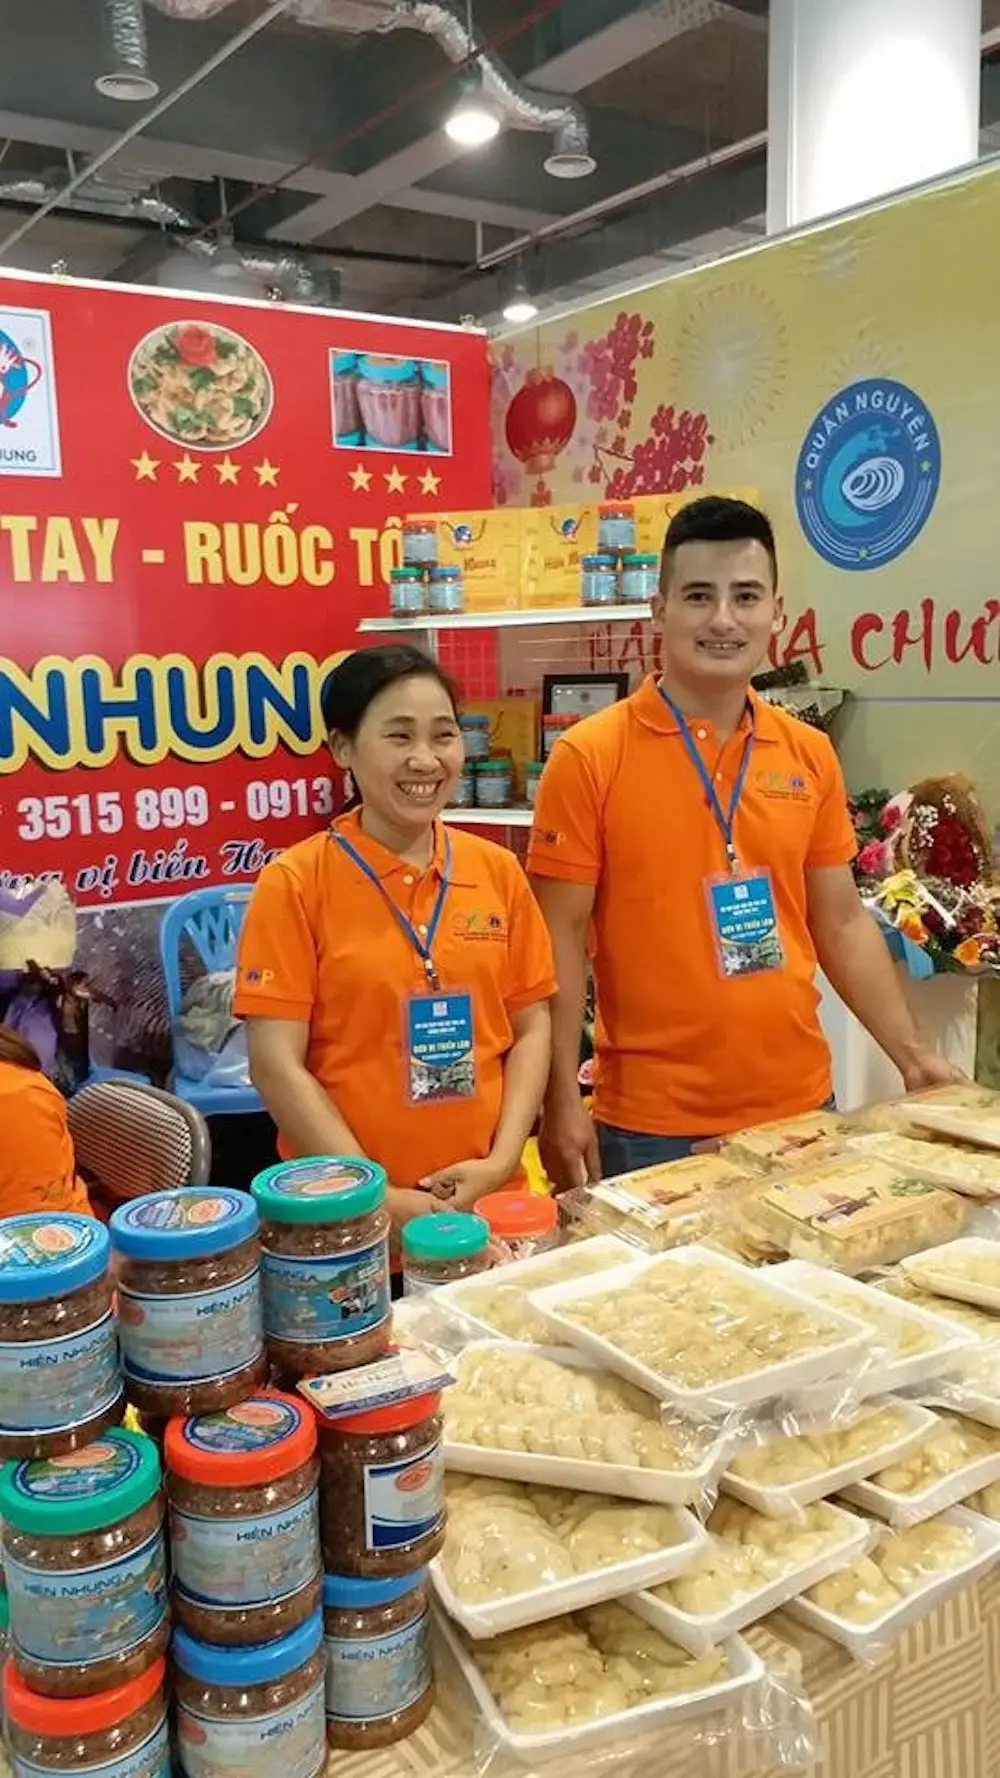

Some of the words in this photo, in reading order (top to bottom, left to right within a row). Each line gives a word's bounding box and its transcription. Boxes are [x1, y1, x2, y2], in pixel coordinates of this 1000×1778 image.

[0, 448, 38, 462] UNG
[1, 516, 120, 583] TAY
[183, 503, 335, 587] RUỐC
[851, 597, 1000, 674] CHƯ
[0, 653, 340, 771] NHUN
[17, 796, 124, 842] 3515
[135, 785, 209, 830] 899
[246, 776, 333, 823] 0913
[76, 856, 119, 898] vị
